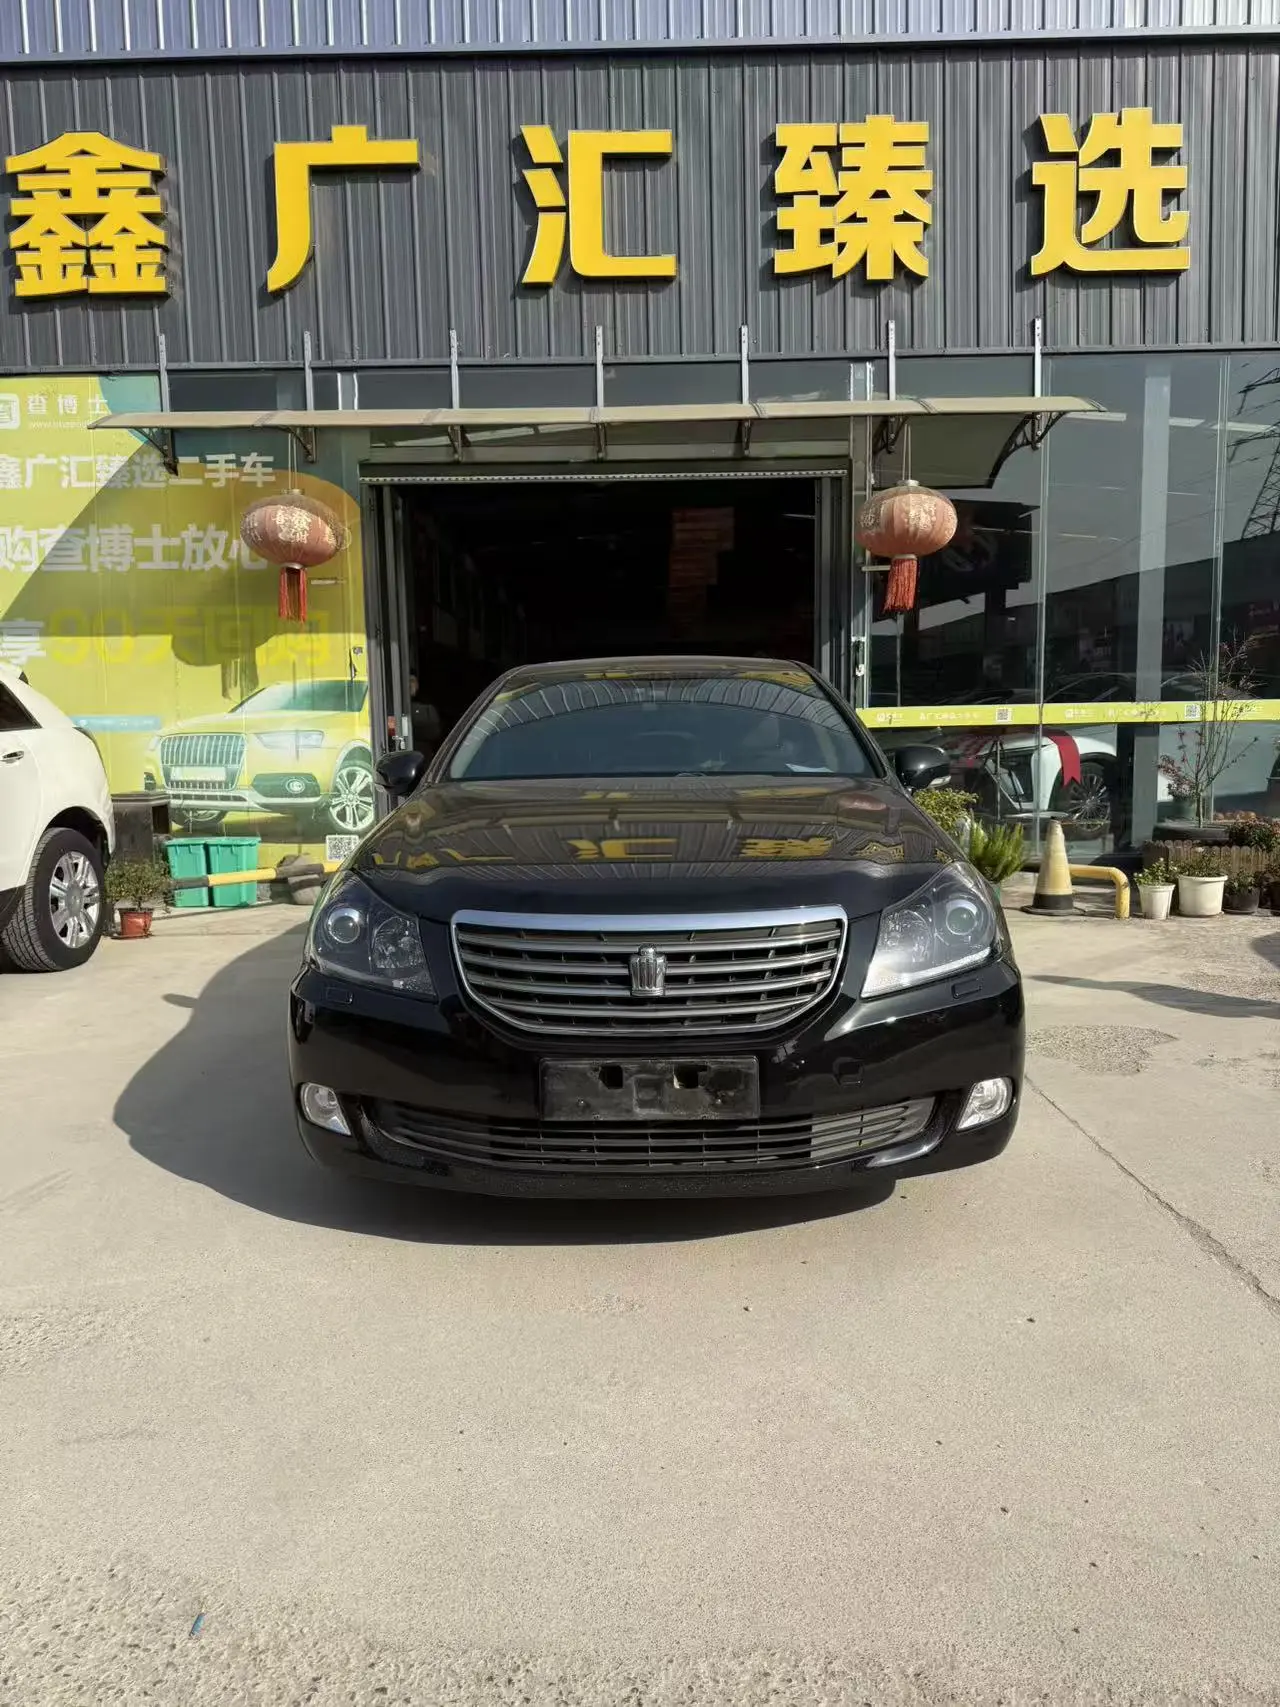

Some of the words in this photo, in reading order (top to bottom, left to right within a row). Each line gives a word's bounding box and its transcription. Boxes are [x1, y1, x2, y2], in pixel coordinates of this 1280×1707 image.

[5, 107, 1191, 297] 鑫广汇臻选
[27, 394, 108, 414] 查博士
